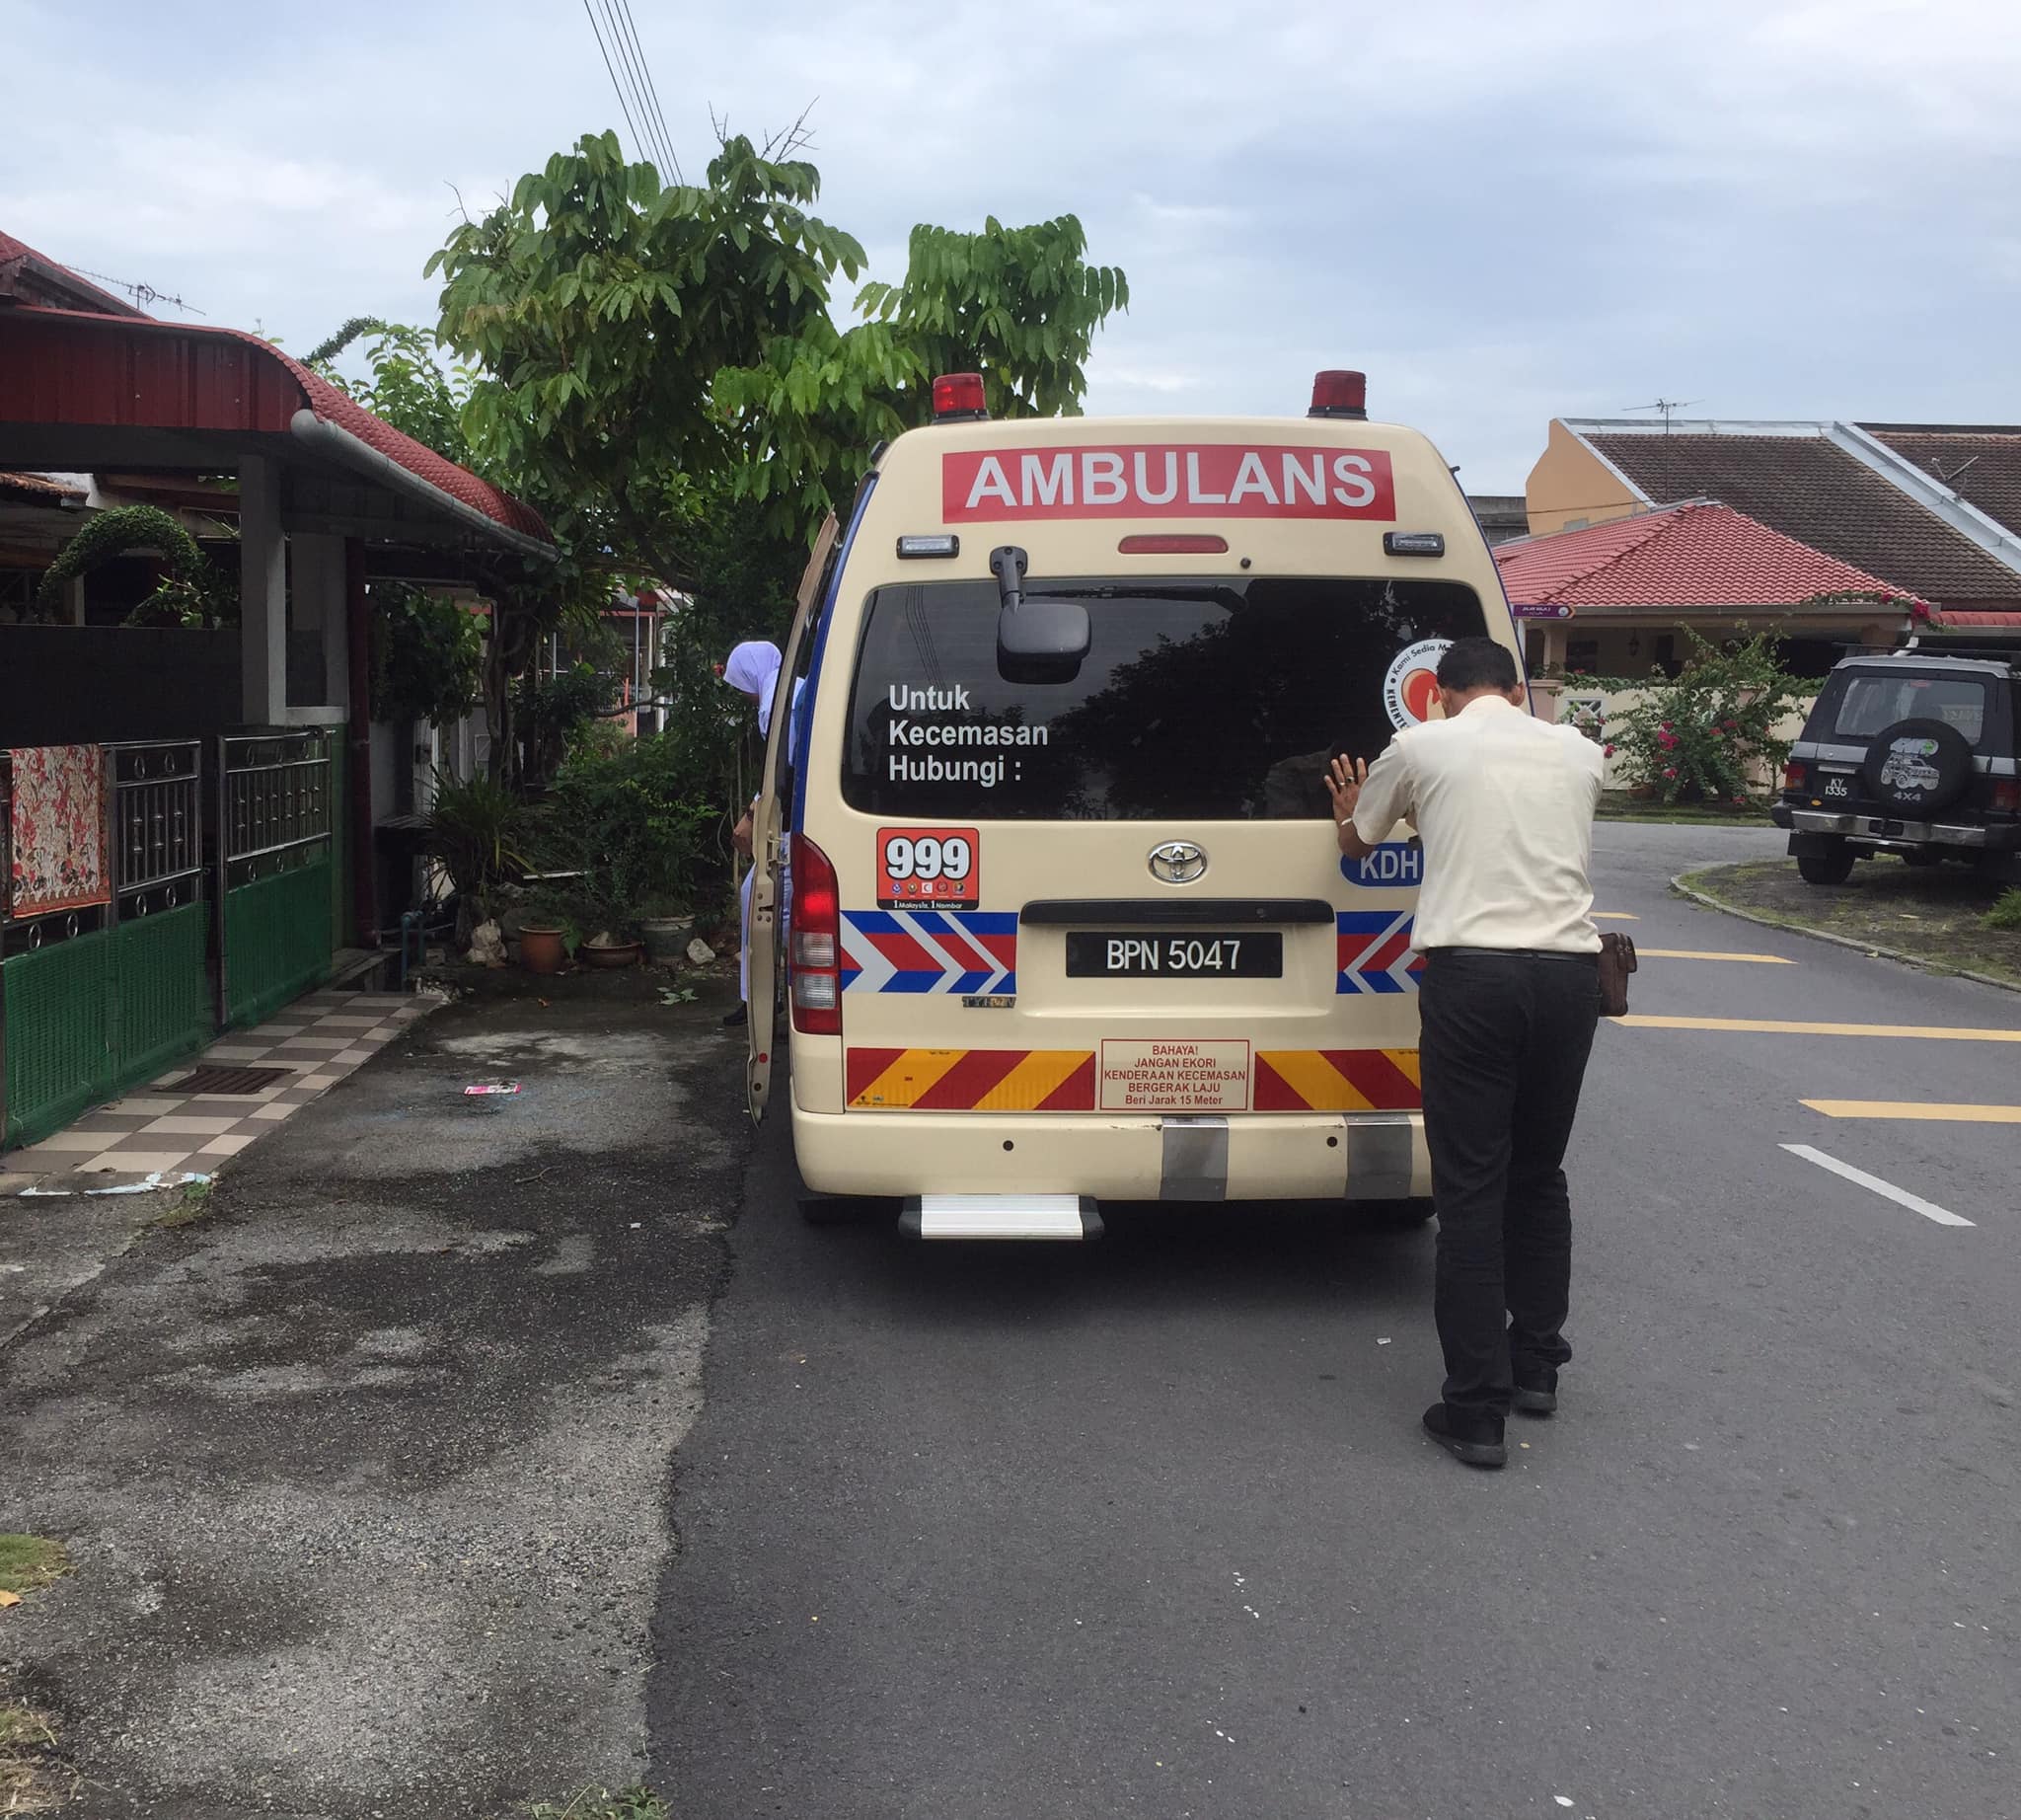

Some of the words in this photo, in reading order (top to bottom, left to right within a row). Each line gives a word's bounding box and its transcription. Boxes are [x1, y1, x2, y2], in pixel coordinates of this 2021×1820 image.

[964, 451, 1376, 508] AMBULANS
[1391, 655, 1411, 676] Kami
[1410, 644, 1436, 658] Sedia
[889, 684, 970, 711] Untuk
[1386, 689, 1409, 729] KEMENTE
[889, 720, 1048, 746] Kecemasan
[889, 755, 1005, 788] Hubungi
[1831, 778, 1844, 788] KY
[1825, 786, 1848, 796] 1335
[886, 837, 971, 879] 999
[1360, 850, 1418, 879] KDH
[1106, 940, 1160, 970] BPN
[1167, 940, 1240, 970] 5047
[1134, 1058, 1179, 1068] JANGAN
[1182, 1058, 1217, 1068] EKORI
[1152, 1044, 1199, 1056] BAHAYA!
[1104, 1070, 1174, 1080] KENDERAAN
[1177, 1070, 1246, 1081] KECEMASAN
[1128, 1083, 1190, 1093] BERGERAK
[1192, 1083, 1221, 1093] LAJU
[1125, 1095, 1146, 1104] Beri
[1149, 1095, 1177, 1104] Jarak
[1180, 1096, 1191, 1104] 15
[1194, 1096, 1224, 1105] Meter
